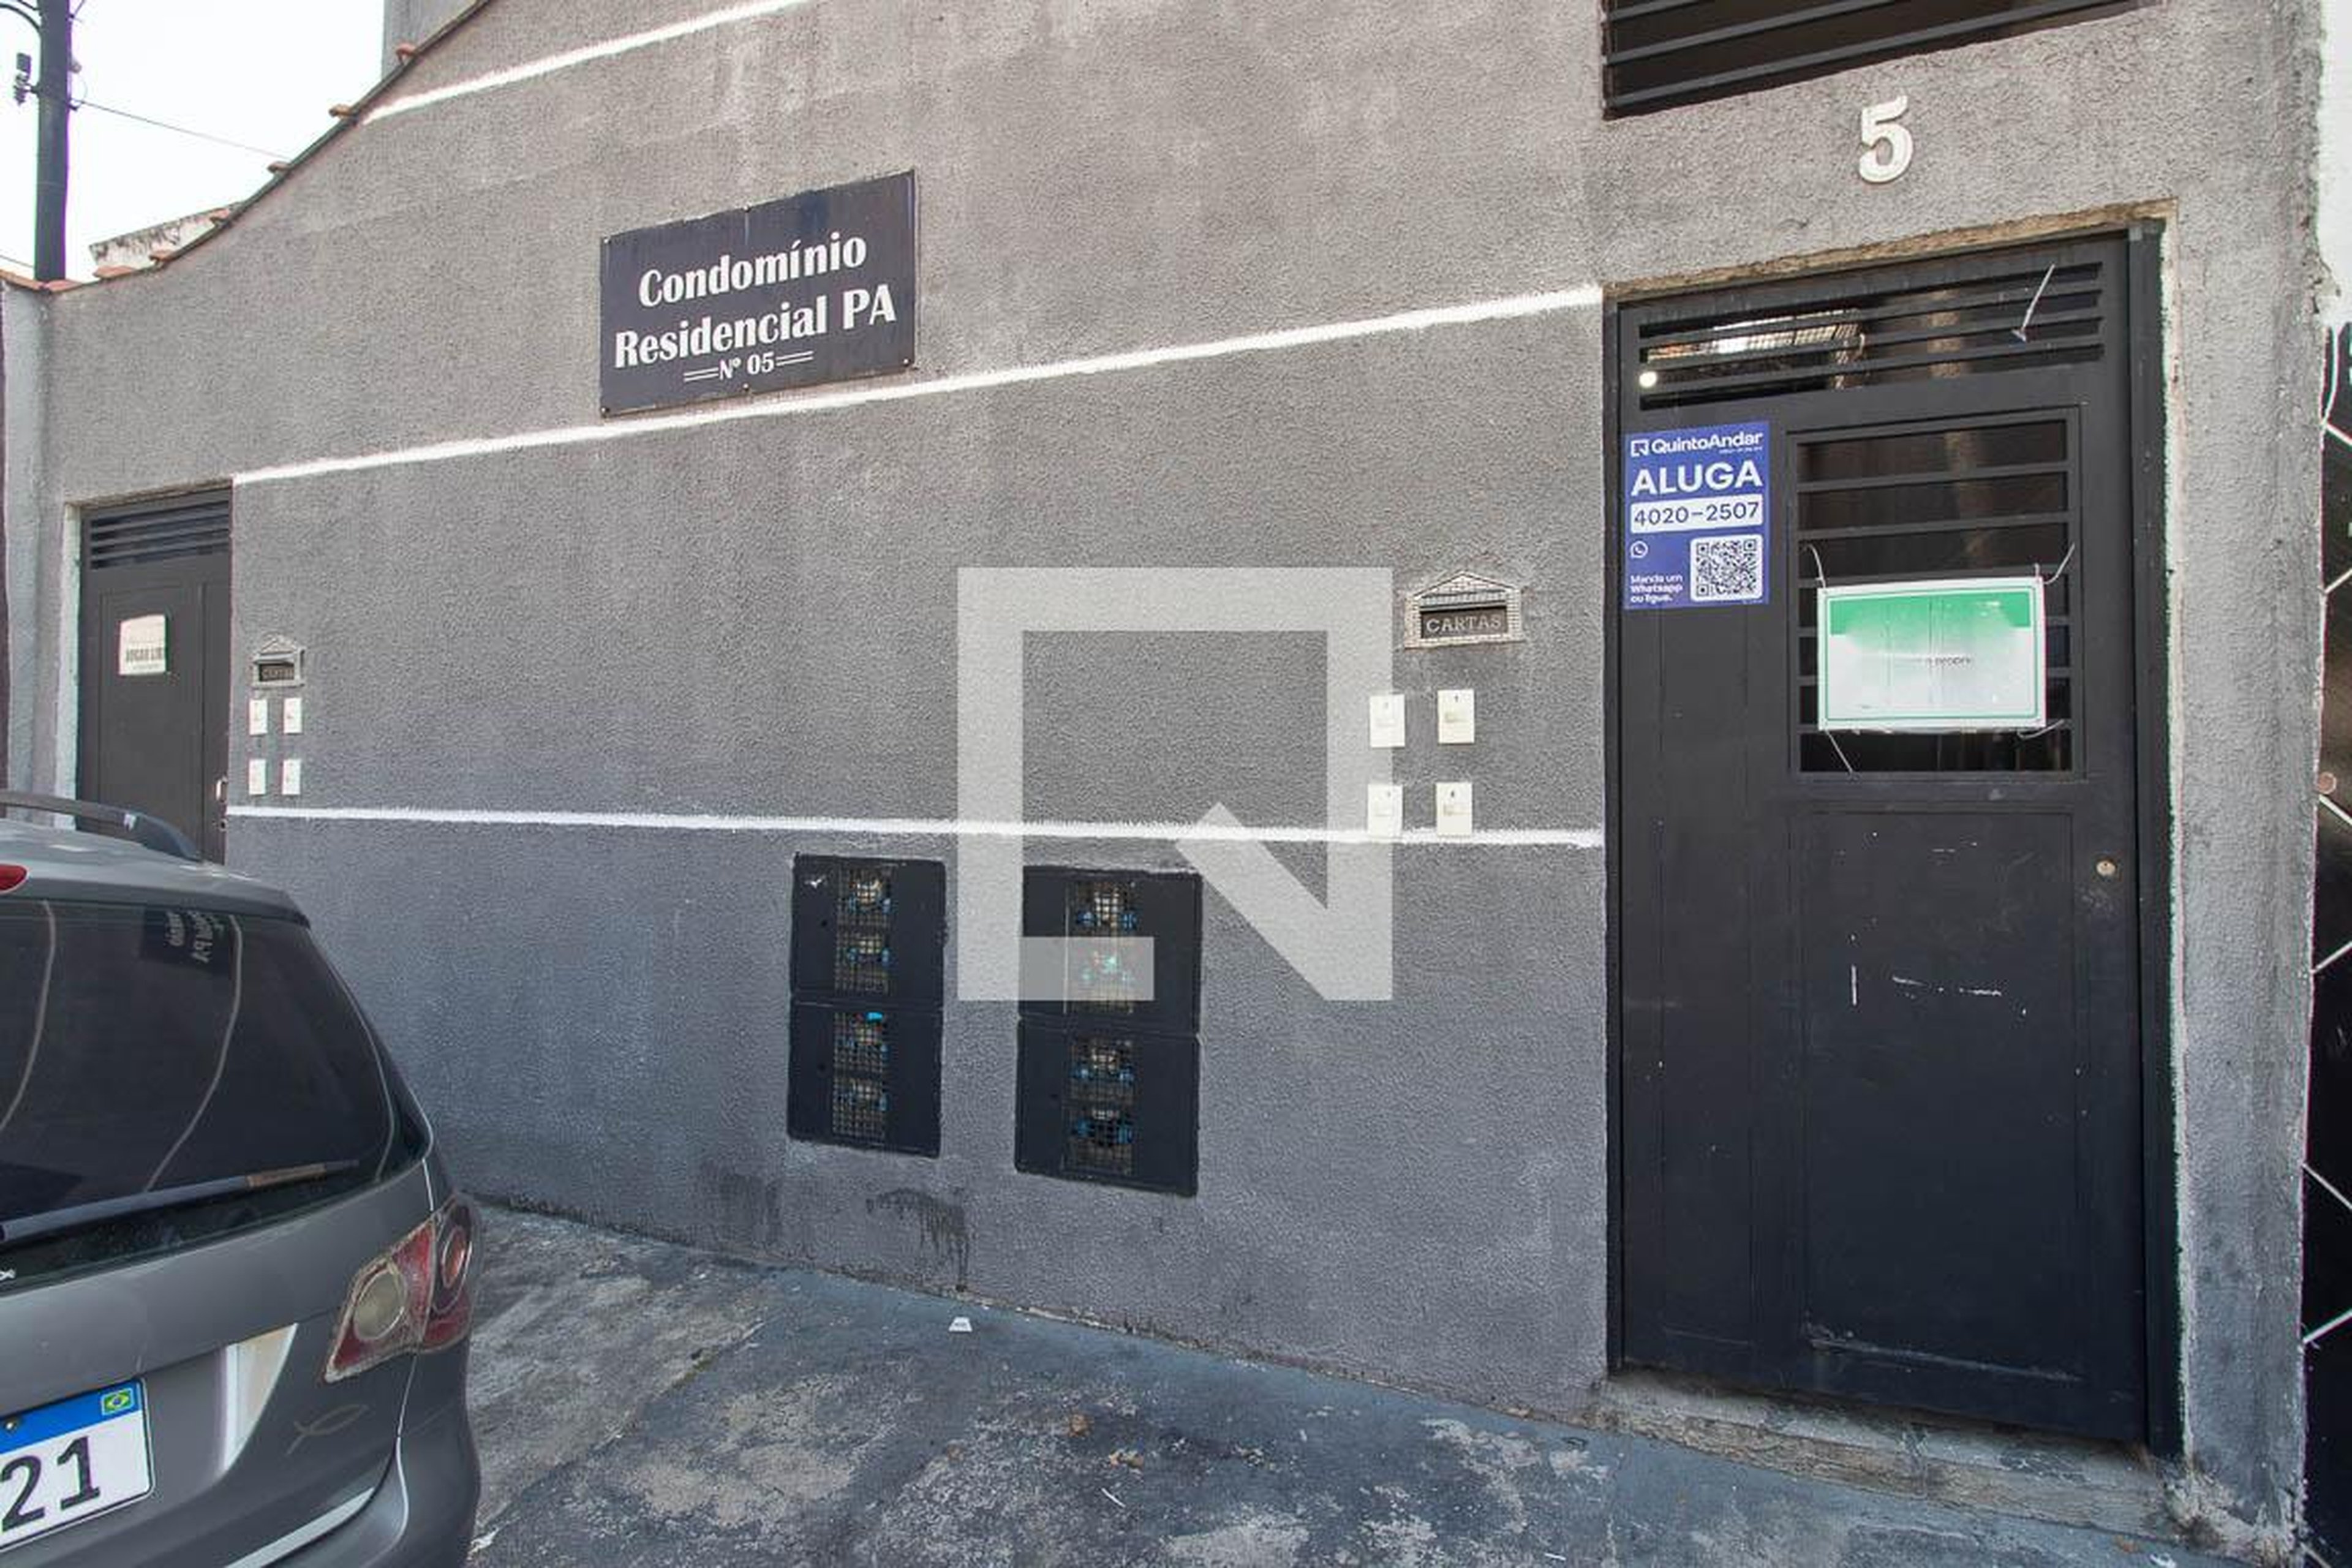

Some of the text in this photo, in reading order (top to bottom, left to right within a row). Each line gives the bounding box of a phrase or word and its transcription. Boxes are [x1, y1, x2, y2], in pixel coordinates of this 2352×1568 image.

[1859, 95, 1913, 183] 5
[639, 231, 867, 307] Condomínio
[615, 284, 896, 368] Residencial PA
[747, 351, 774, 375] 05
[1651, 431, 1763, 454] QuintoAndar
[1630, 459, 1763, 496] ALUGA
[1634, 501, 1760, 527] 4020-2507
[1426, 616, 1502, 634] CARTAS
[0, 1436, 100, 1531] 21
